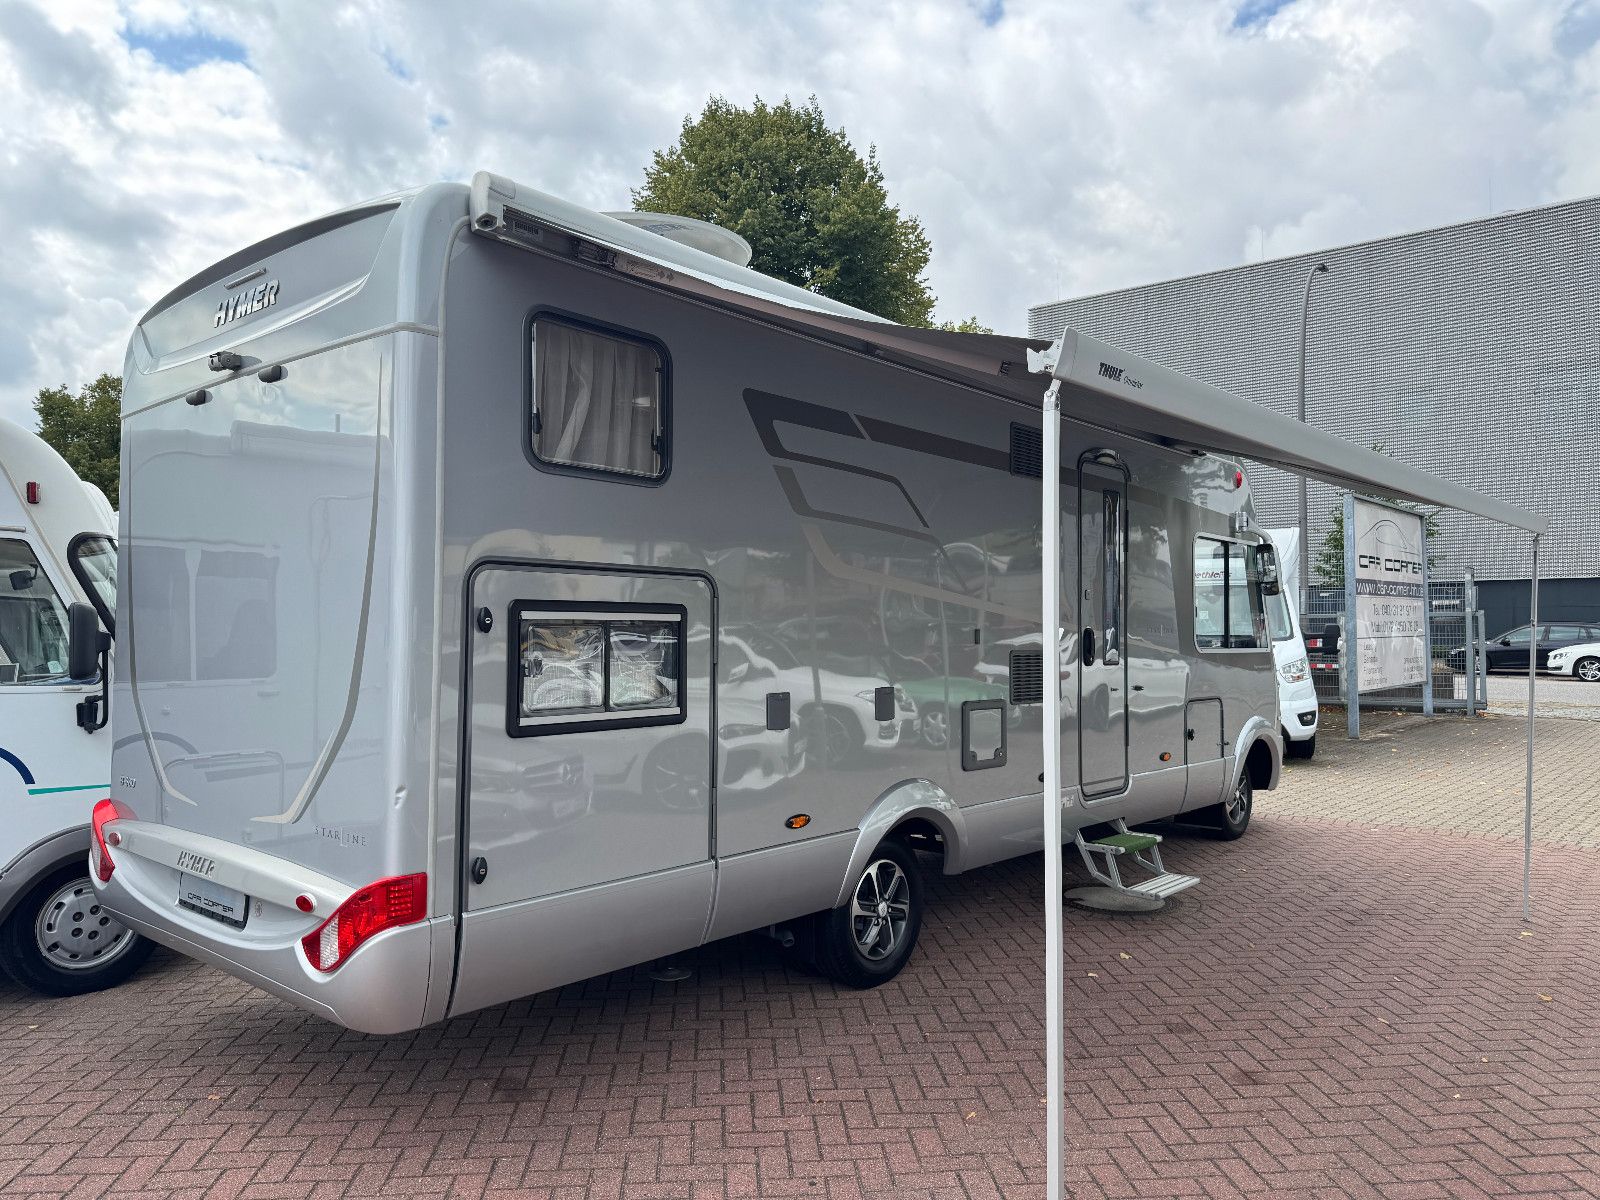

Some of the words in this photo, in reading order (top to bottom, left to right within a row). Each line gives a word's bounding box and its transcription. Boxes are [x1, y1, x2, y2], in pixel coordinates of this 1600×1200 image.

[213, 279, 280, 329] HYMER
[1098, 361, 1124, 382] THULE
[1358, 554, 1382, 571] CAR
[1384, 558, 1423, 575] CORNER
[177, 850, 216, 876] HYMER
